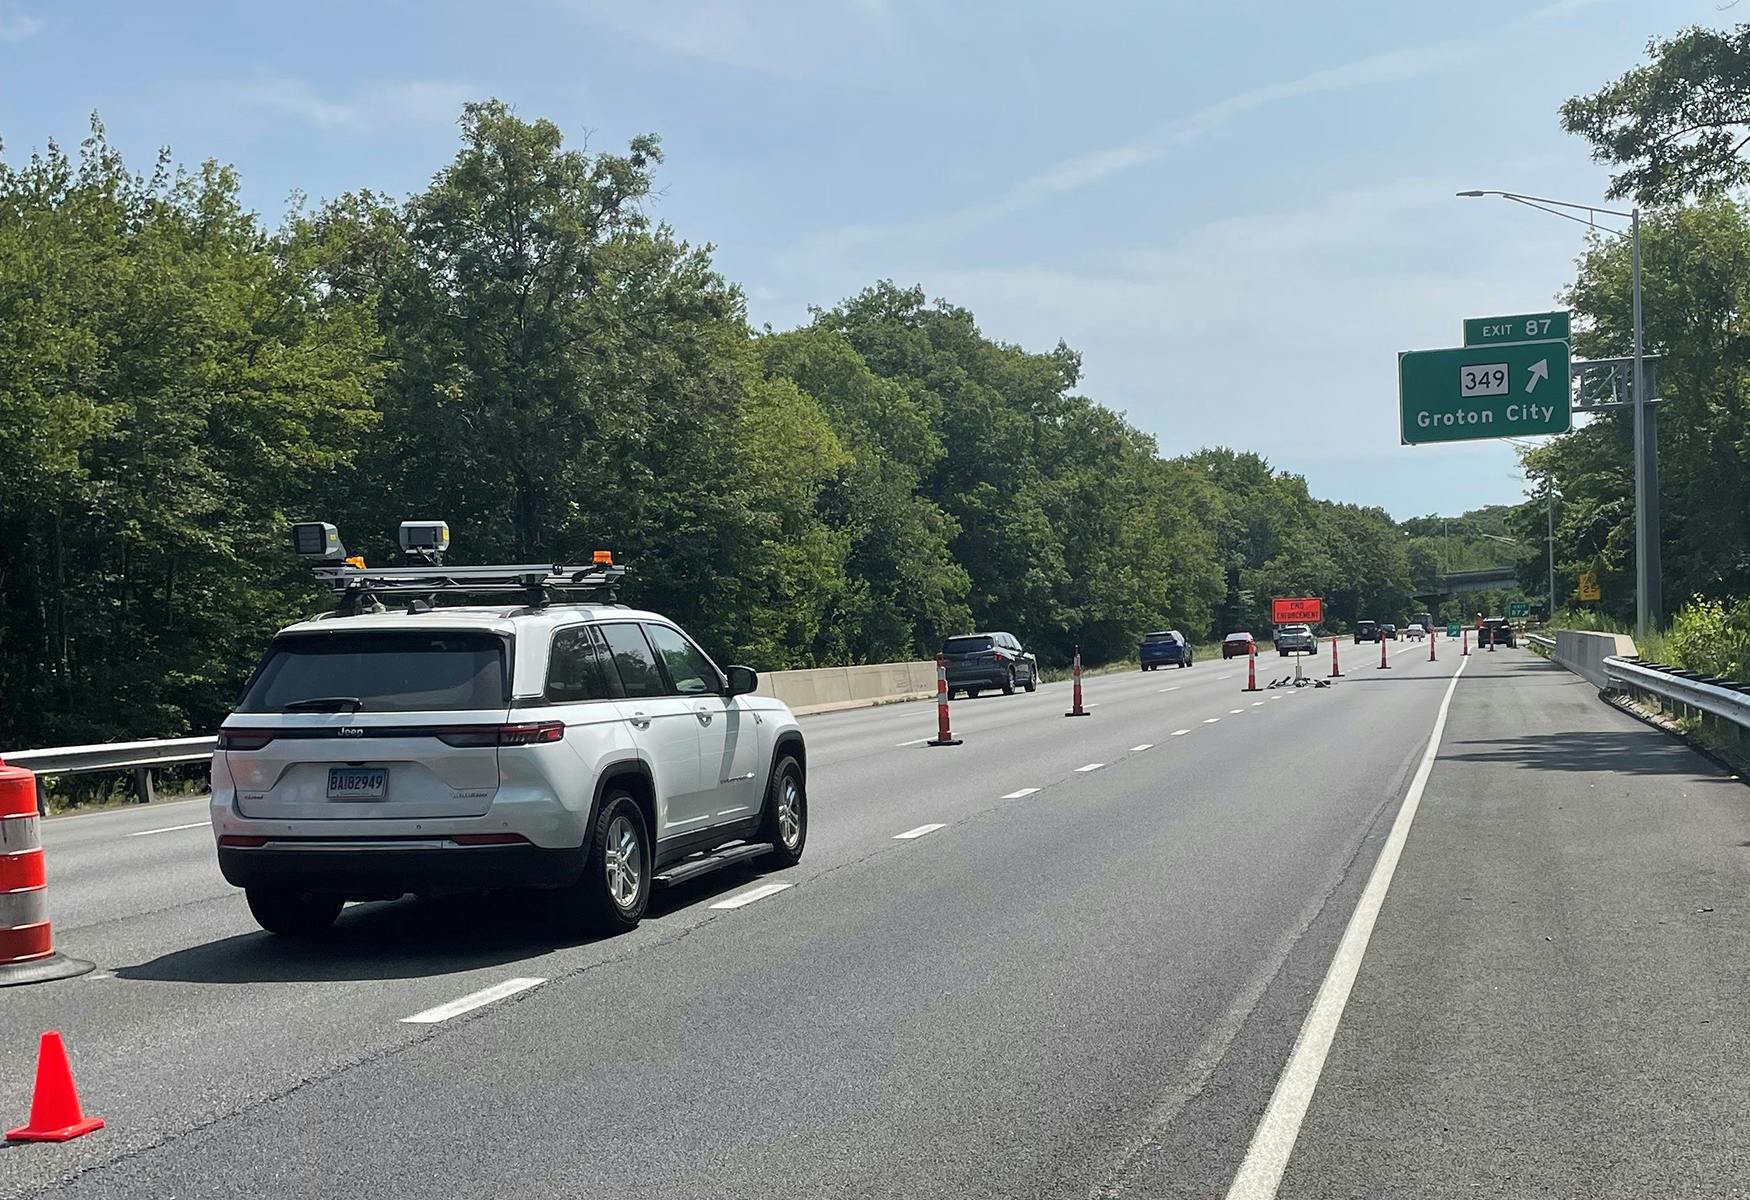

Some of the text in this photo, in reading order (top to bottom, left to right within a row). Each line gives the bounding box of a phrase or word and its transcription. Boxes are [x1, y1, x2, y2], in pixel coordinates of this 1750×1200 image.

[1482, 319, 1551, 337] EXIT 87
[1465, 370, 1505, 391] 349
[1417, 403, 1554, 428] Groton City
[1290, 602, 1304, 610] END
[337, 727, 364, 737] Jeep
